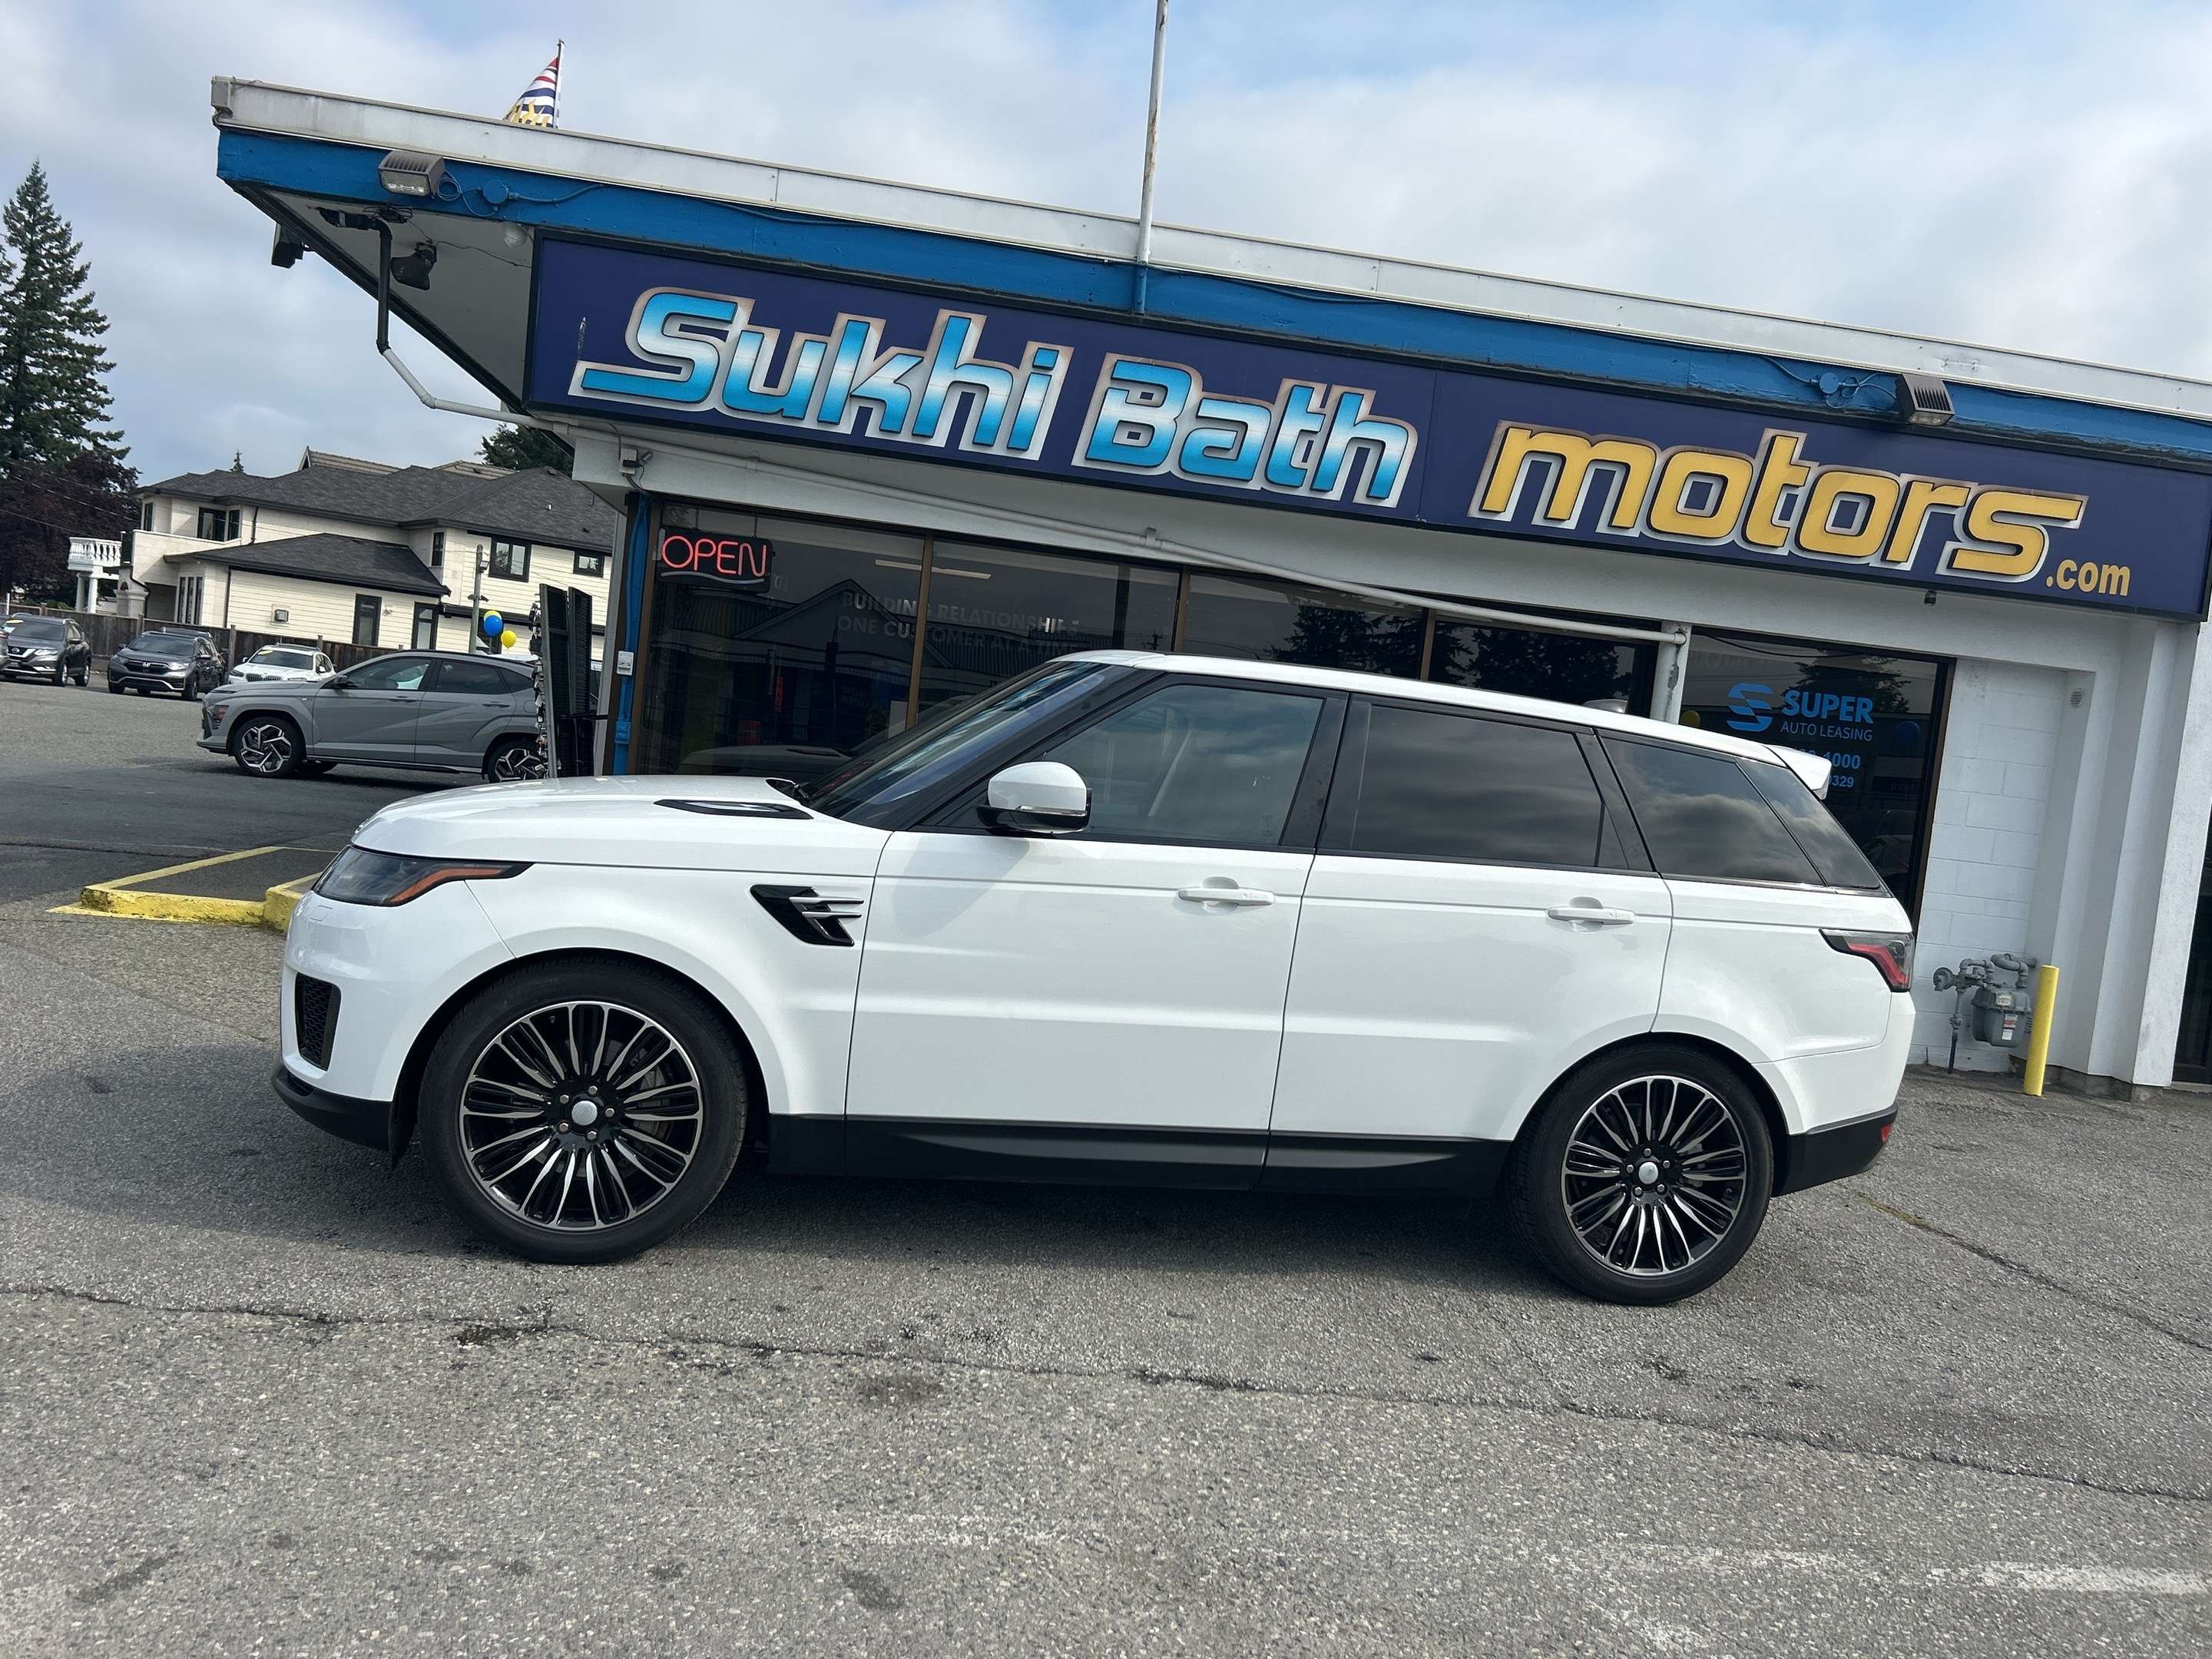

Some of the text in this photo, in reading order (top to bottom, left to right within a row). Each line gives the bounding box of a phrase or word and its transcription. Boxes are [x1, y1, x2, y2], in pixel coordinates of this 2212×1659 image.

[568, 287, 2131, 596] Sukhi Bath motors .com
[662, 535, 767, 578] OPEN
[842, 591, 932, 617] BUILDIN
[837, 614, 879, 635] ONE
[883, 621, 986, 647] CUOMER
[1782, 690, 1873, 724] SUPER
[1780, 721, 1873, 741] AUTO LEASING
[1828, 775, 1854, 787] 329
